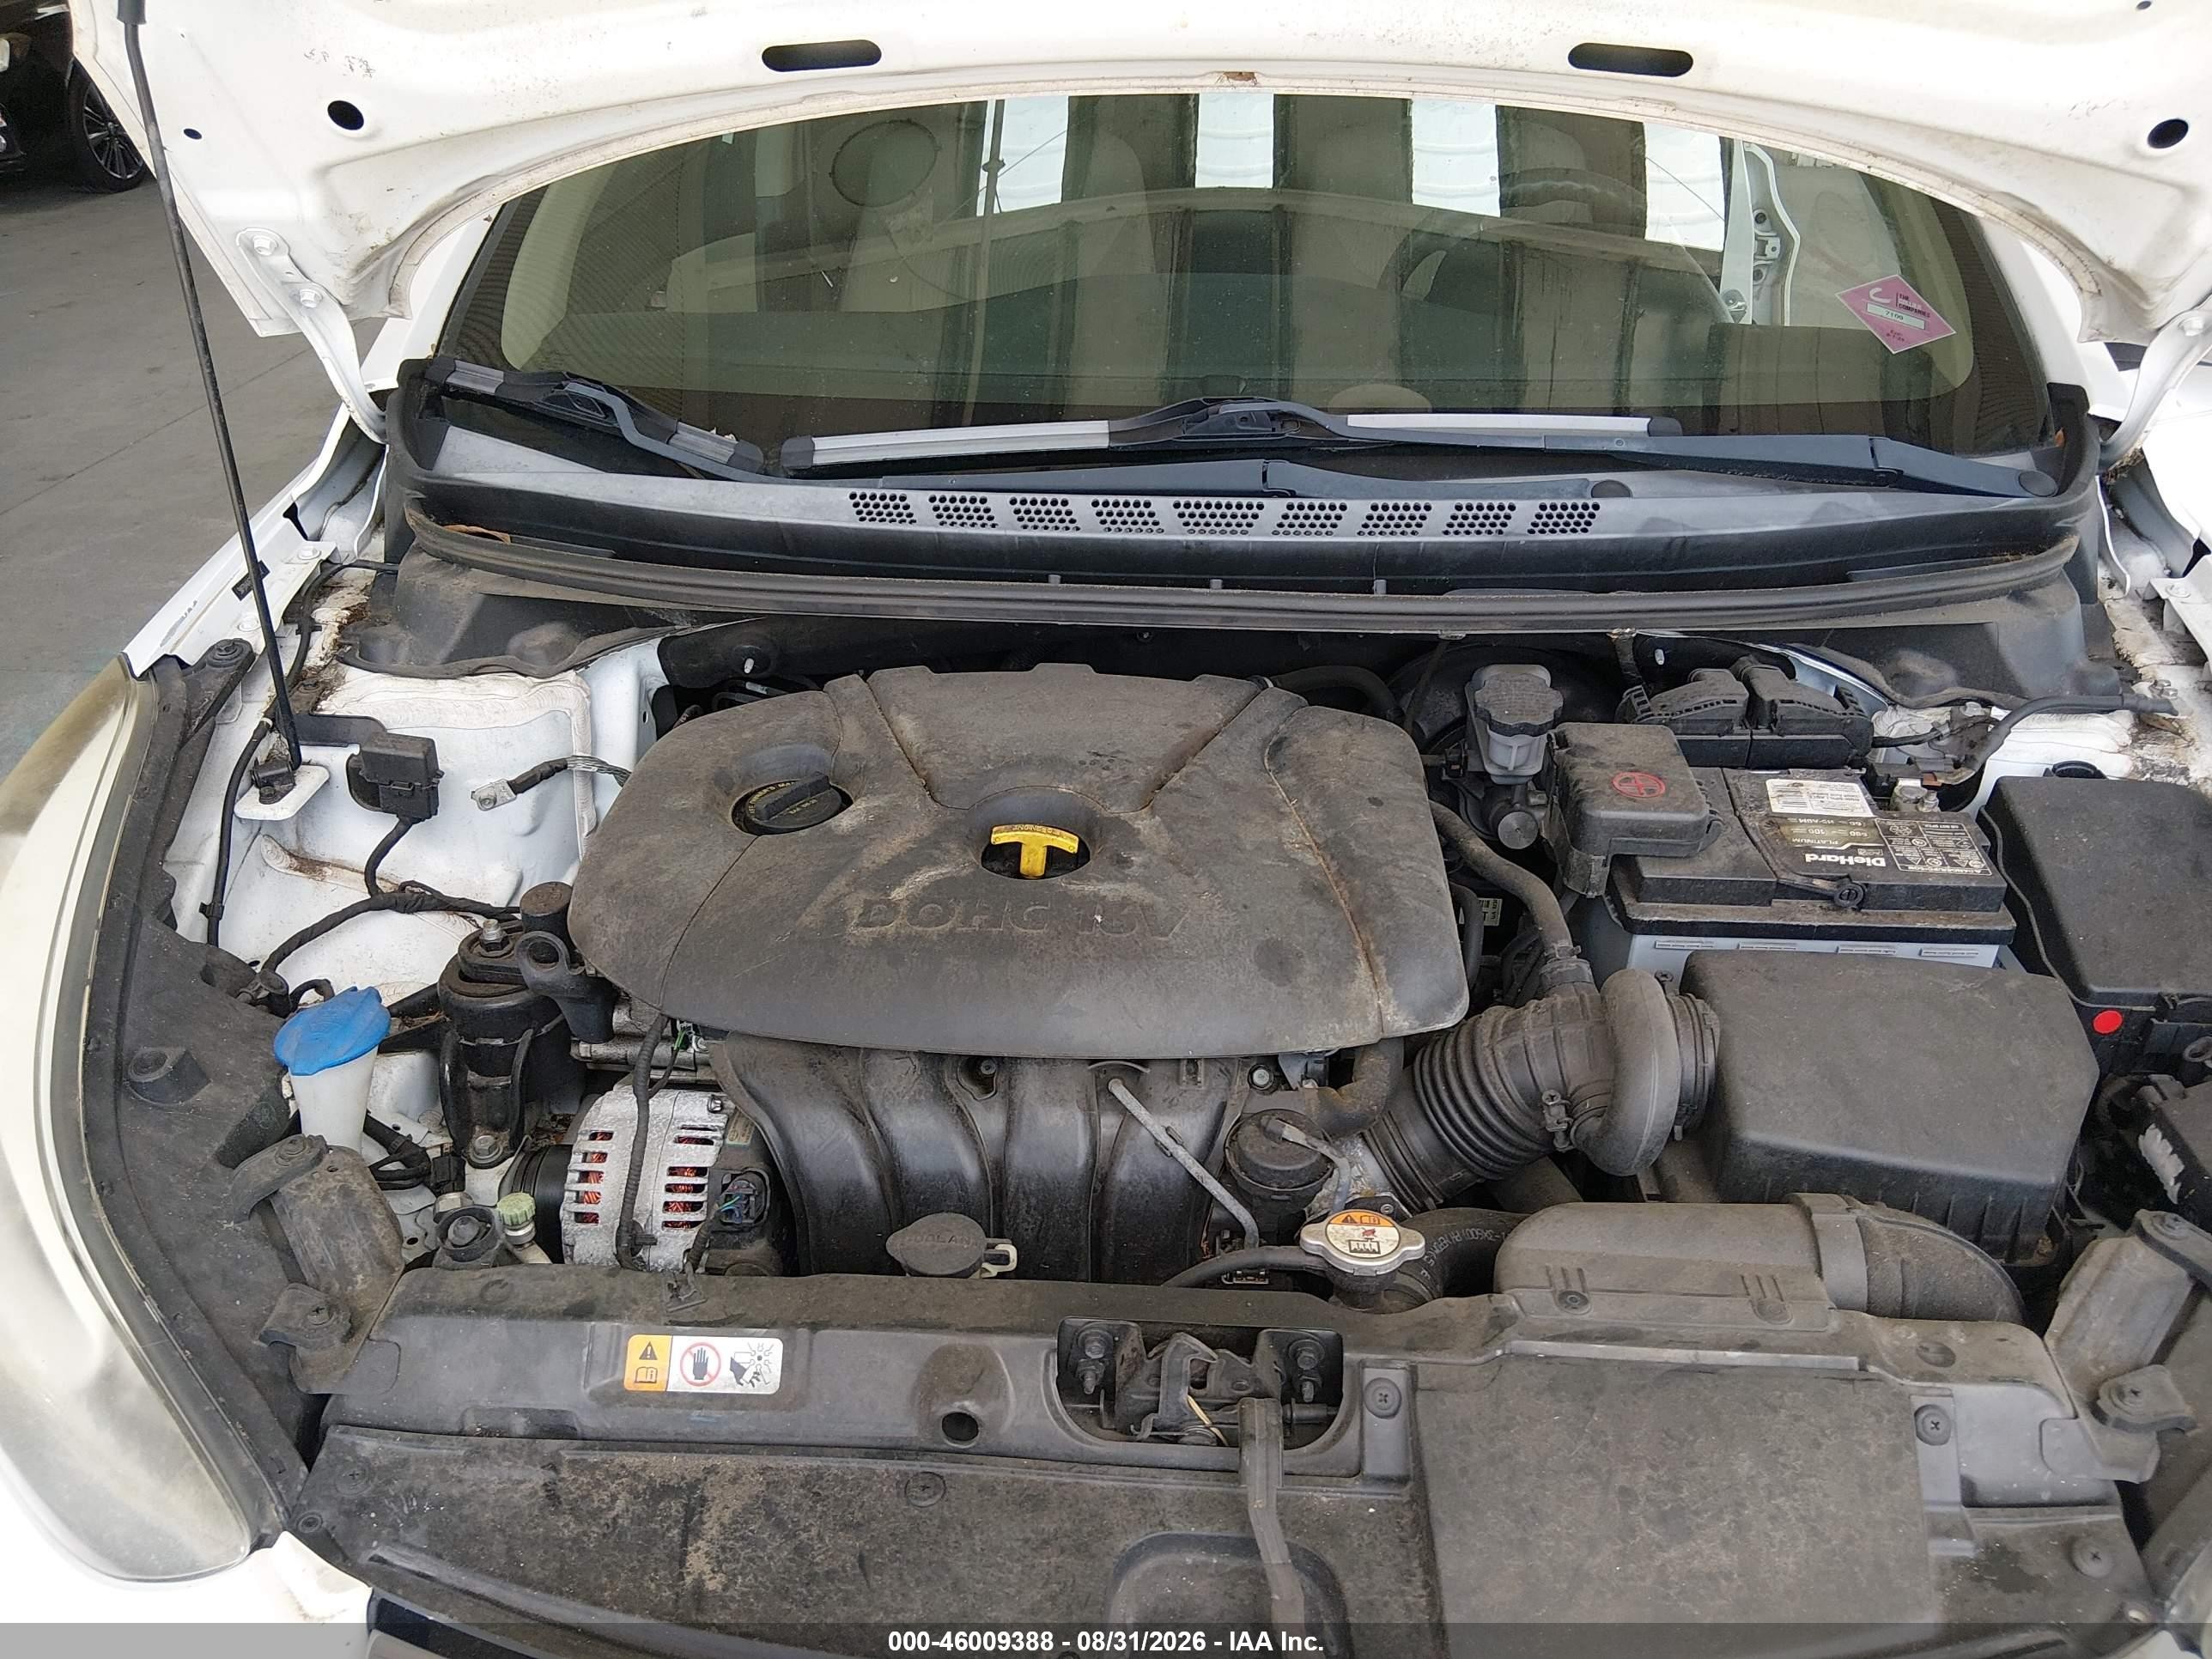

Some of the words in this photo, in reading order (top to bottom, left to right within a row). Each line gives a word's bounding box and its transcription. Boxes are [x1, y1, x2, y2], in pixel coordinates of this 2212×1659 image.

[1792, 837, 1839, 846] PLATINUM
[1804, 853, 1887, 867] DieHard
[852, 898, 1052, 933] DOHC
